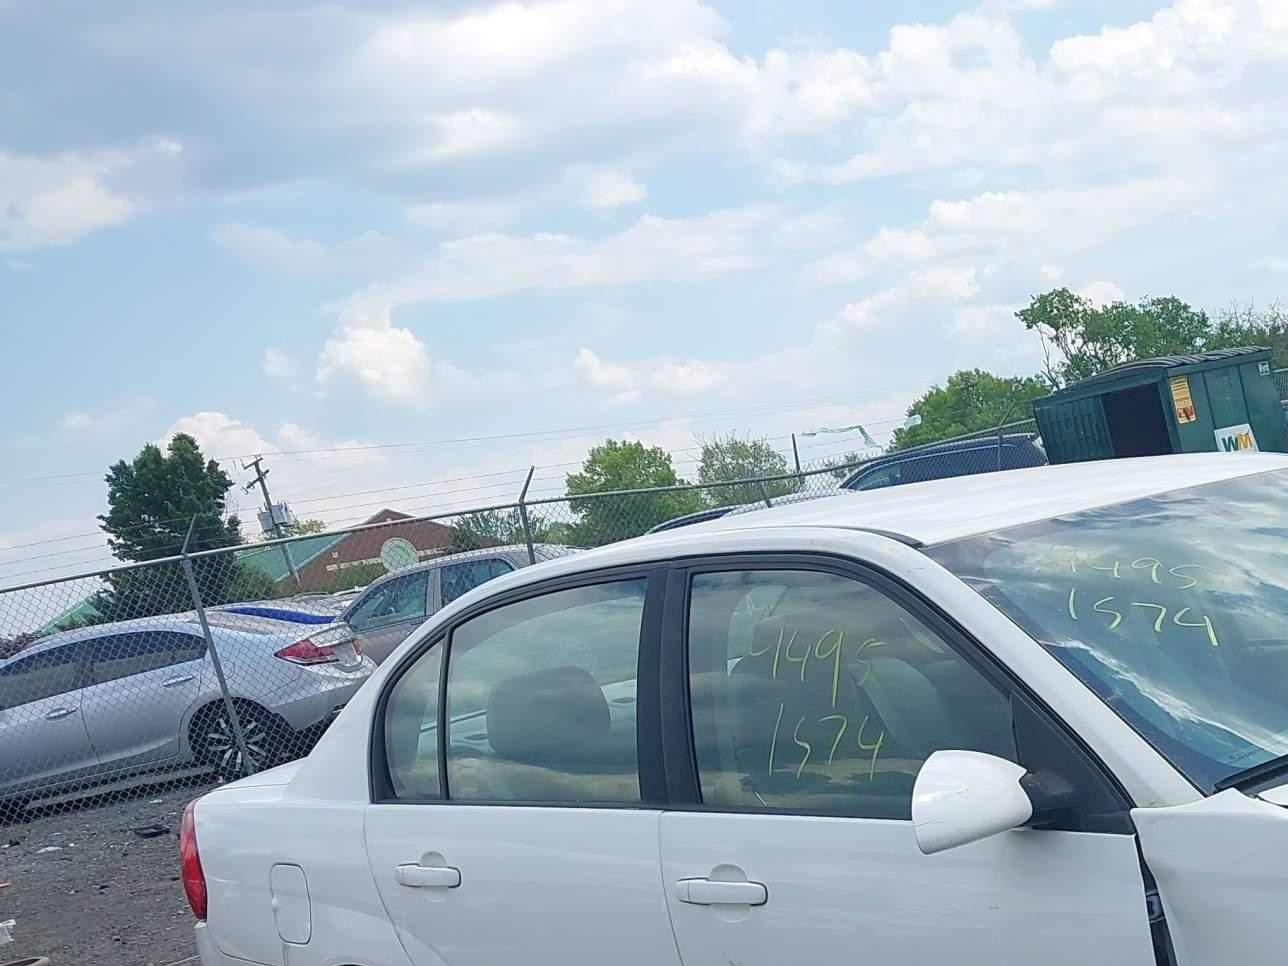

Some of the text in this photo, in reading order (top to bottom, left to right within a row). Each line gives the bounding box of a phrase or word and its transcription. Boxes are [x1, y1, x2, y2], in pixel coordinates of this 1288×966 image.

[1221, 430, 1253, 452] WM
[1068, 587, 1219, 647] 1574
[750, 626, 889, 708] 4495
[768, 703, 886, 782] 1574
